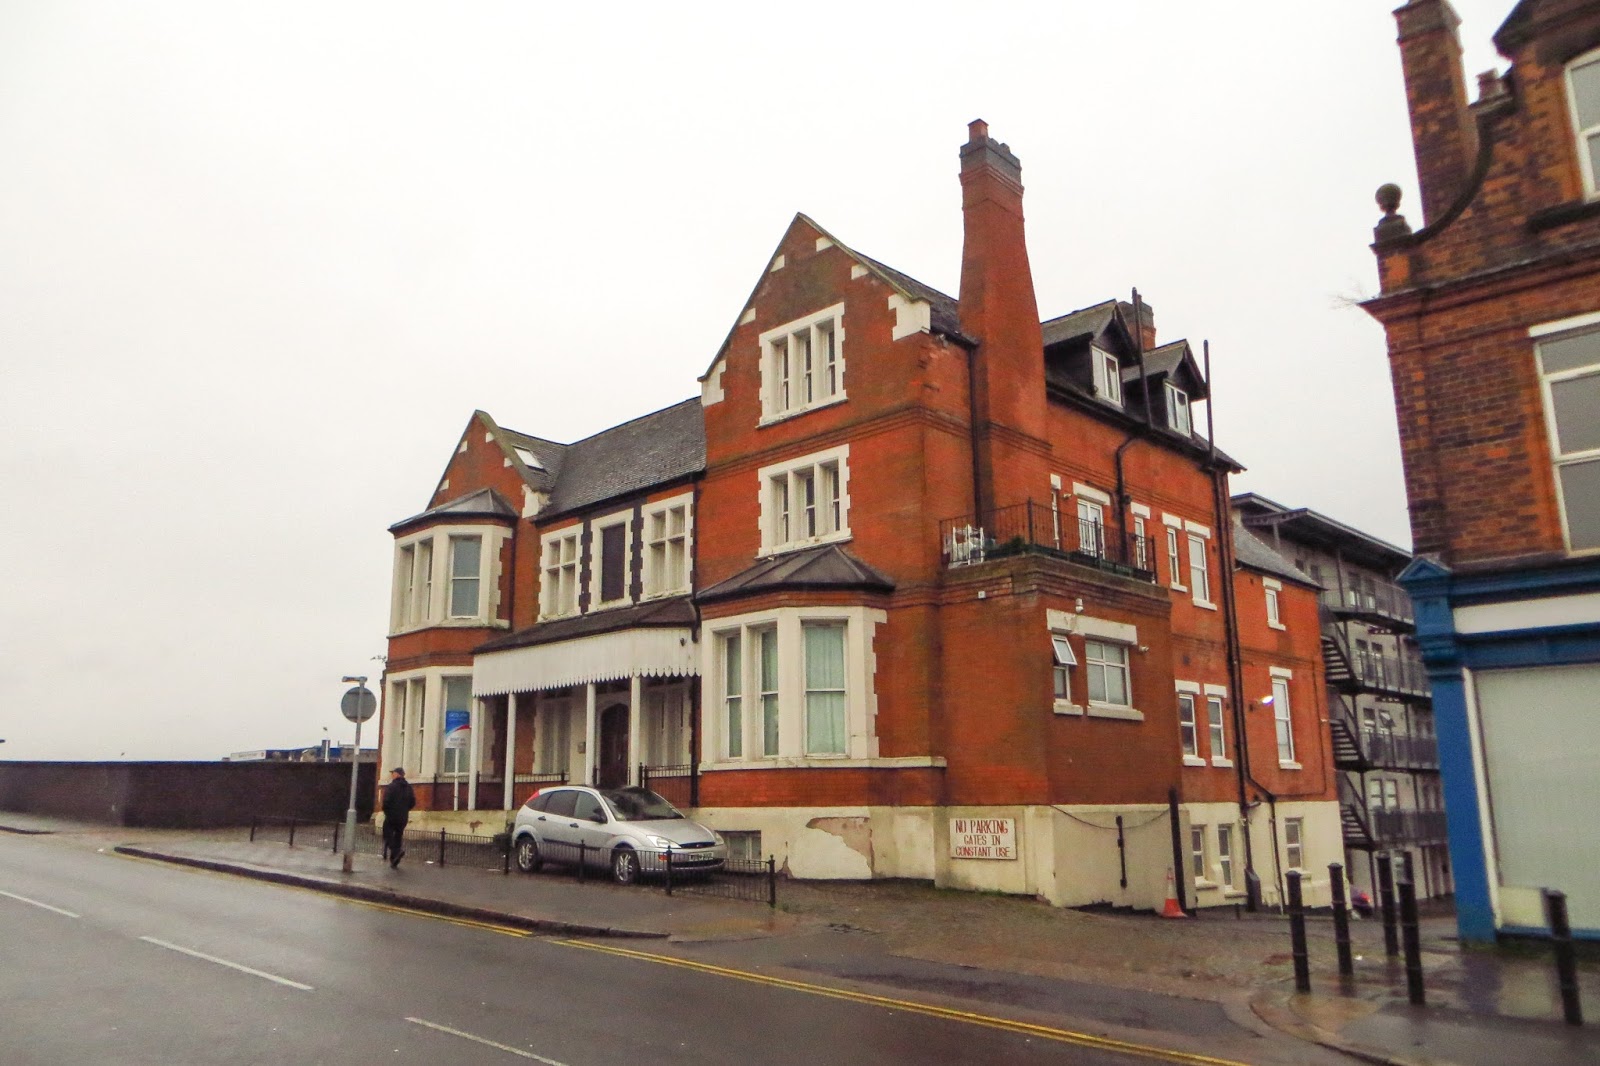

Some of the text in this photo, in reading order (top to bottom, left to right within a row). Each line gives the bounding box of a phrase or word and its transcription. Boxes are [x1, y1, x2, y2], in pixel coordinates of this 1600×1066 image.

[955, 820, 1008, 834] NO PARKING
[963, 835, 1001, 845] GATES IN
[955, 846, 1010, 857] CONSTANT USE
